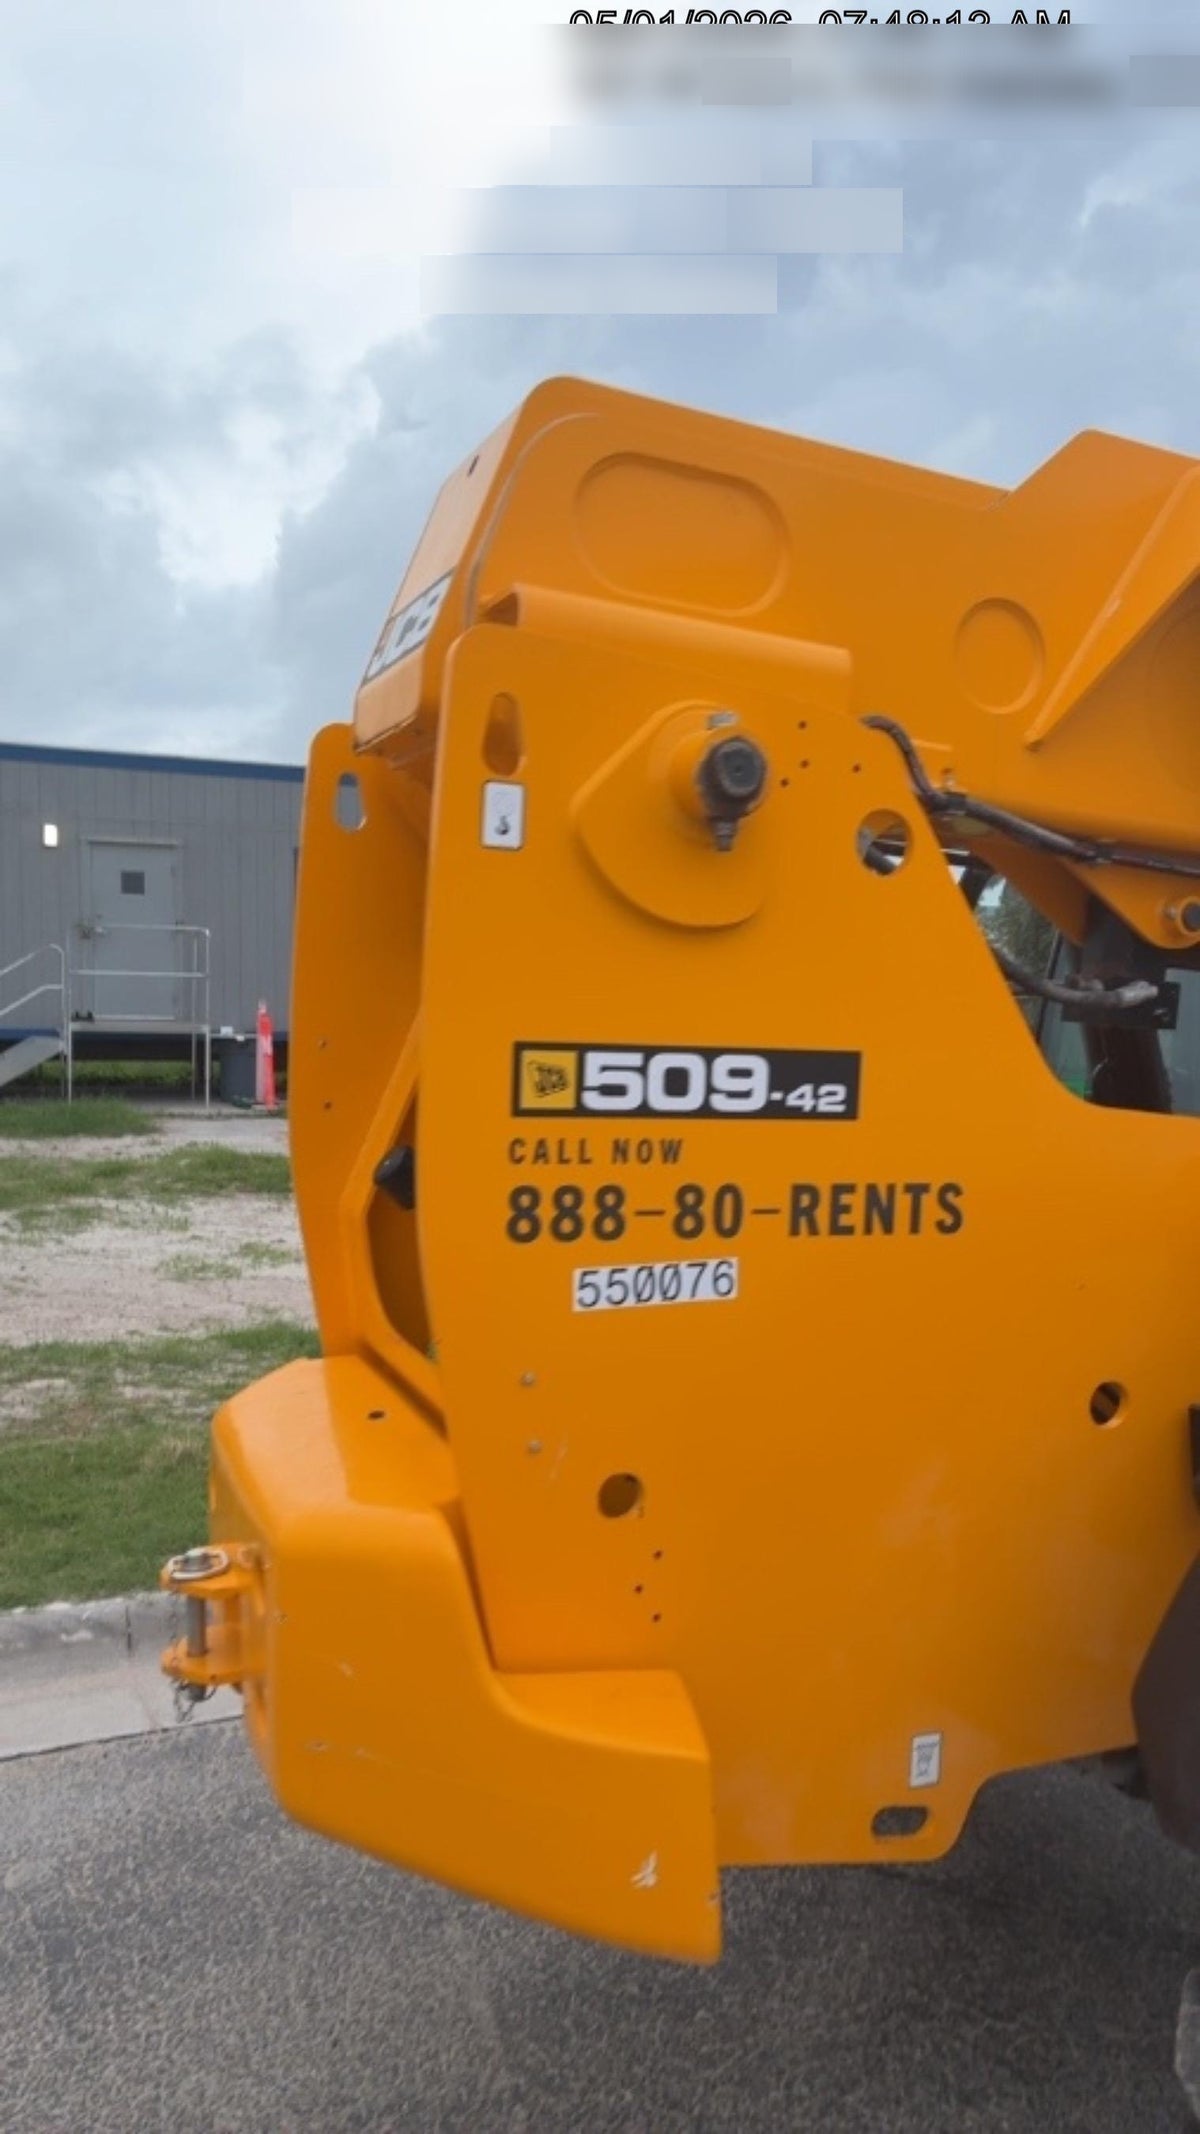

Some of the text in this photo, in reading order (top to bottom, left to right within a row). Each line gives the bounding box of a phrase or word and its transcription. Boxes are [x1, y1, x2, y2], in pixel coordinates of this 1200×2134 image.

[581, 1051, 847, 1113] 509-42
[507, 1137, 683, 1165] CALL NOW
[505, 1182, 965, 1244] 888-80-RENTS
[577, 1260, 735, 1309] 550076
